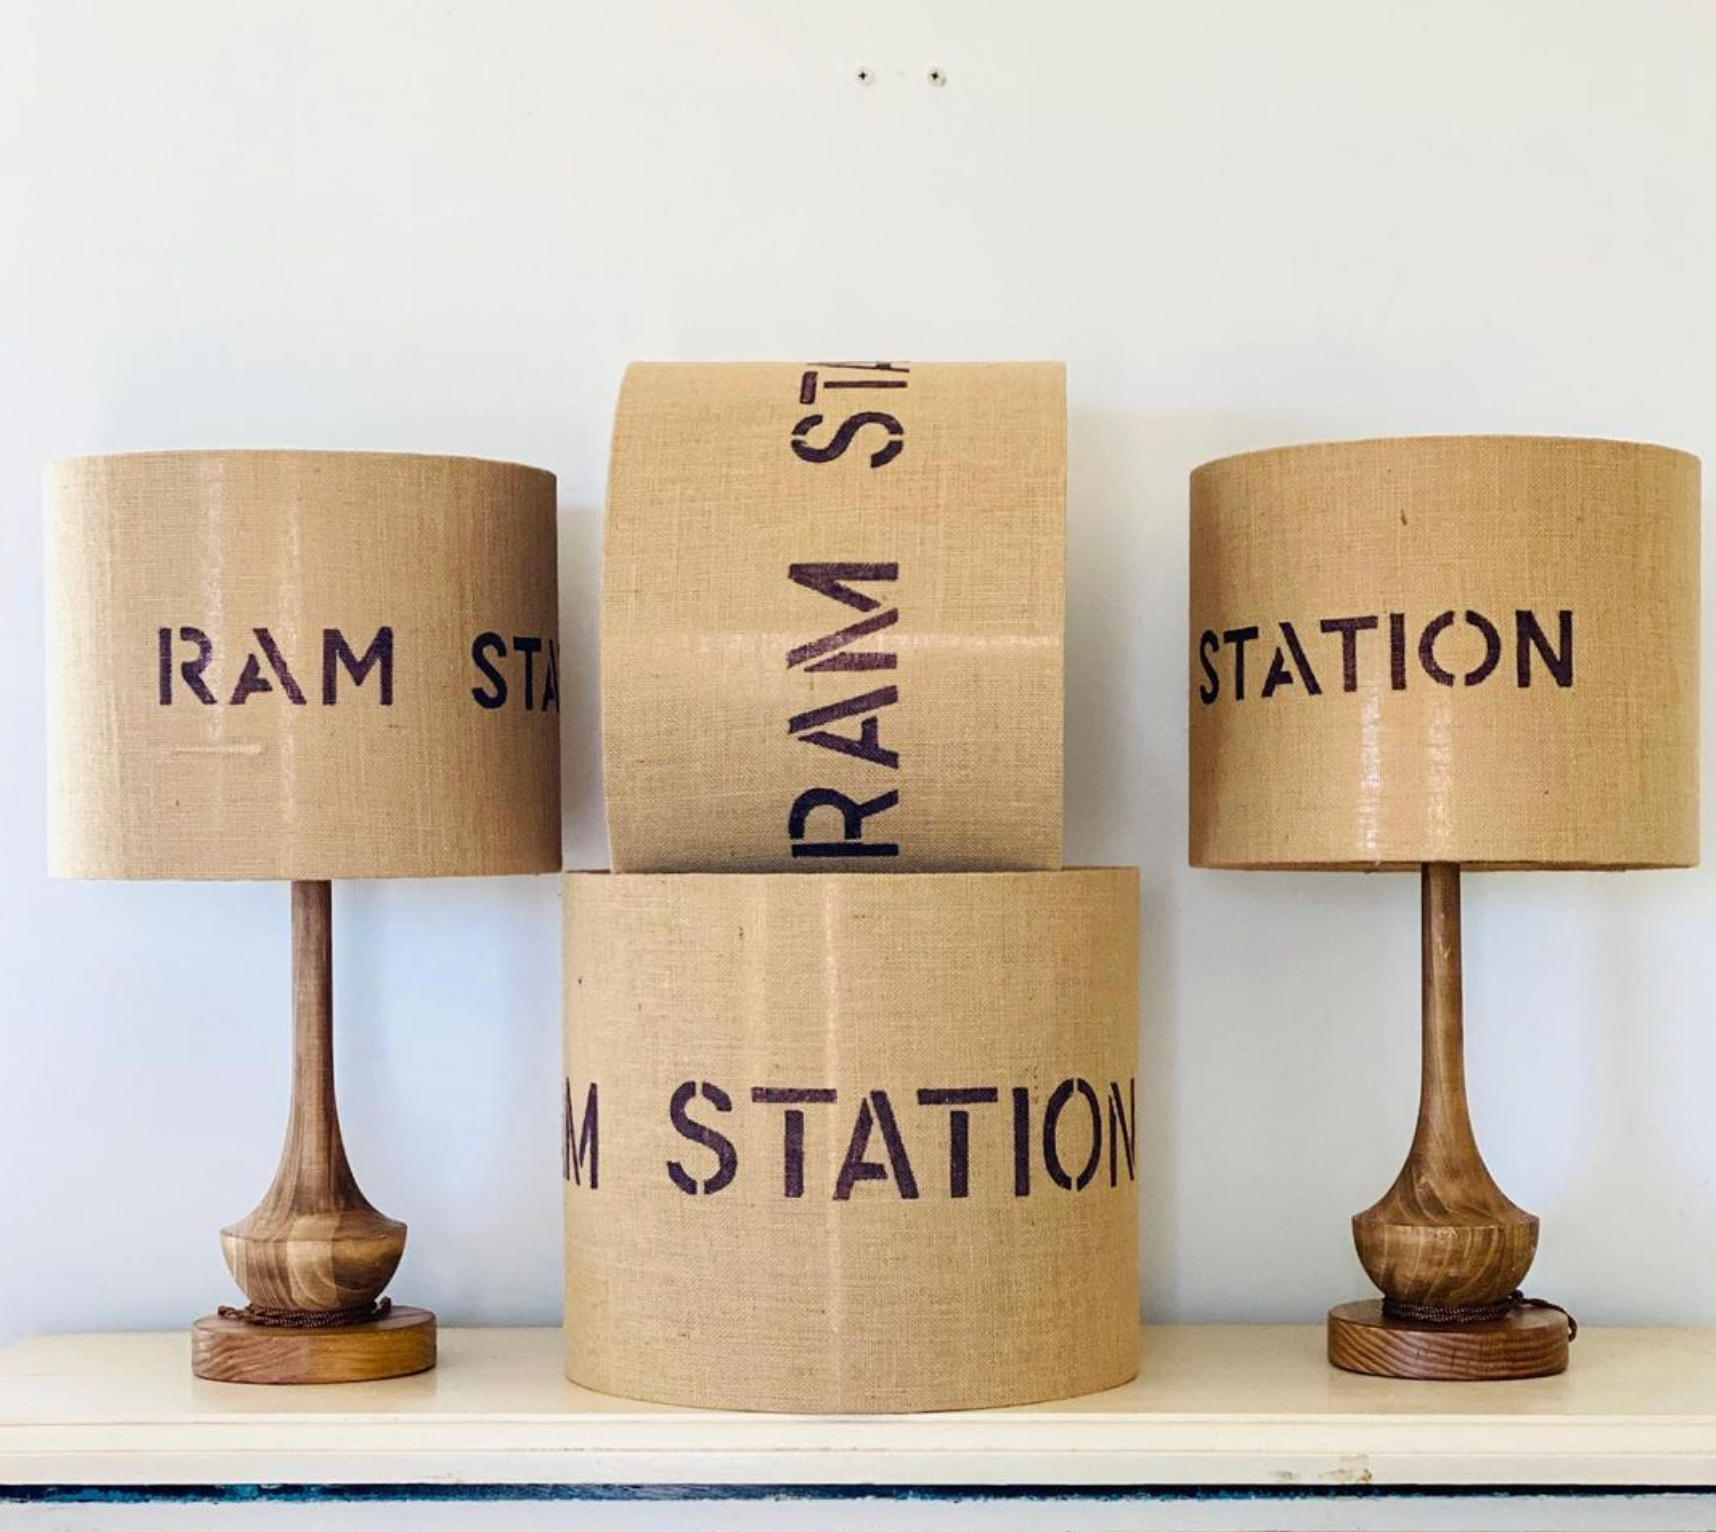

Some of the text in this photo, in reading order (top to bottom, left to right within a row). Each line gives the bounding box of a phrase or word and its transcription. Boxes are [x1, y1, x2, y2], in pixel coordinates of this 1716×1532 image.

[158, 626, 559, 713] RAM STA
[787, 562, 899, 858] RAM
[1200, 609, 1573, 705] STATION
[562, 1077, 1135, 1200] M STATION
